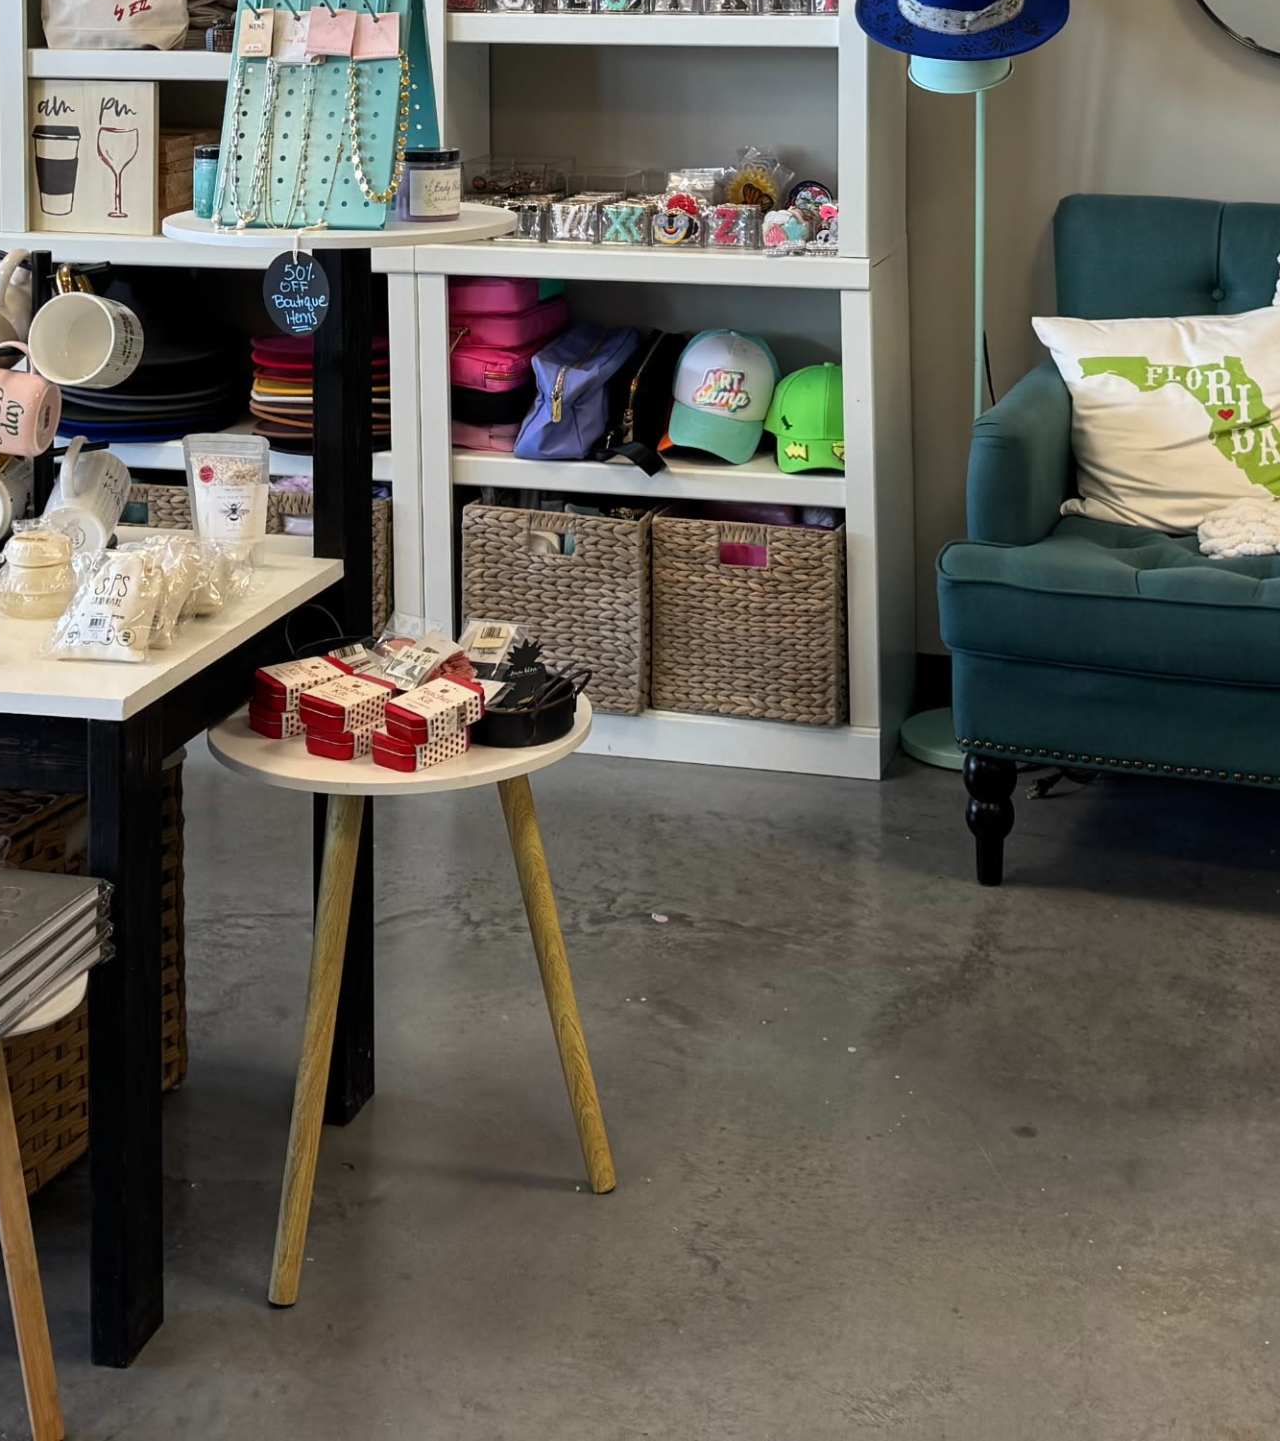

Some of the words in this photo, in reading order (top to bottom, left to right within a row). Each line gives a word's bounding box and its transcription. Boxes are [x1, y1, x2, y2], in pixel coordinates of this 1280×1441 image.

[99, 97, 137, 126] pm
[284, 262, 315, 281] 50%
[280, 280, 309, 293] OFF
[272, 294, 329, 312] Boutique
[0, 400, 25, 436] day
